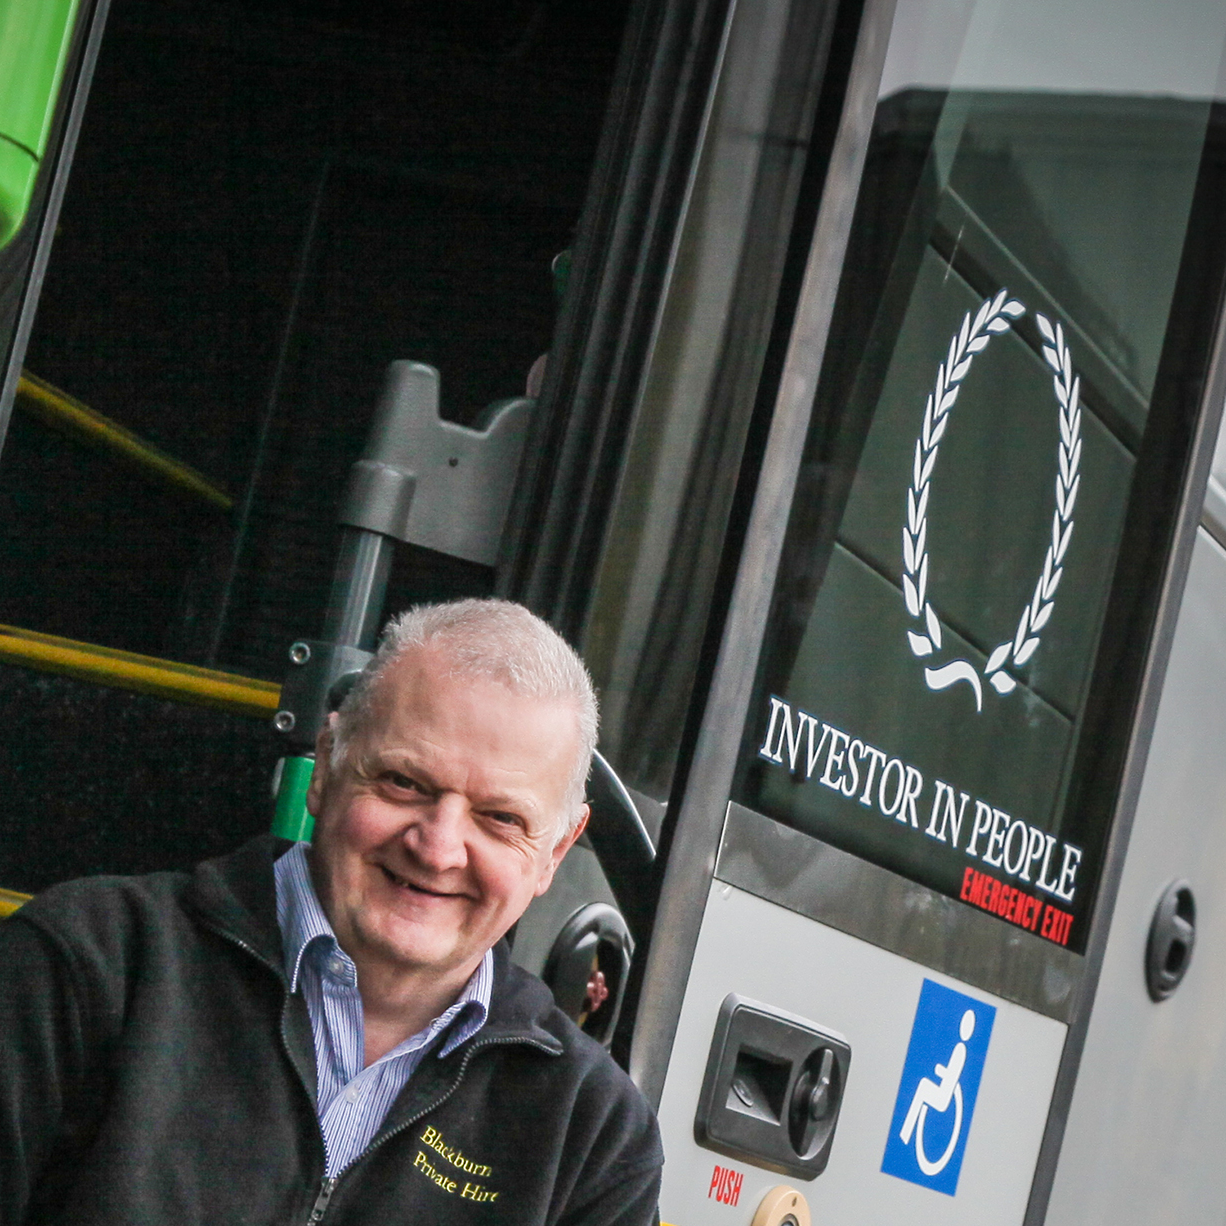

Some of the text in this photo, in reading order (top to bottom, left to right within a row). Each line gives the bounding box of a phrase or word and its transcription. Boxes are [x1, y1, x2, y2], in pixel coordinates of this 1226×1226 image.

[759, 696, 1082, 901] INVESTOR IN PEOPLE
[960, 866, 1073, 946] EMERGENCY EXIT
[413, 1151, 457, 1193] Private
[419, 1125, 492, 1177] Blackburn
[708, 1165, 744, 1207] PUSH
